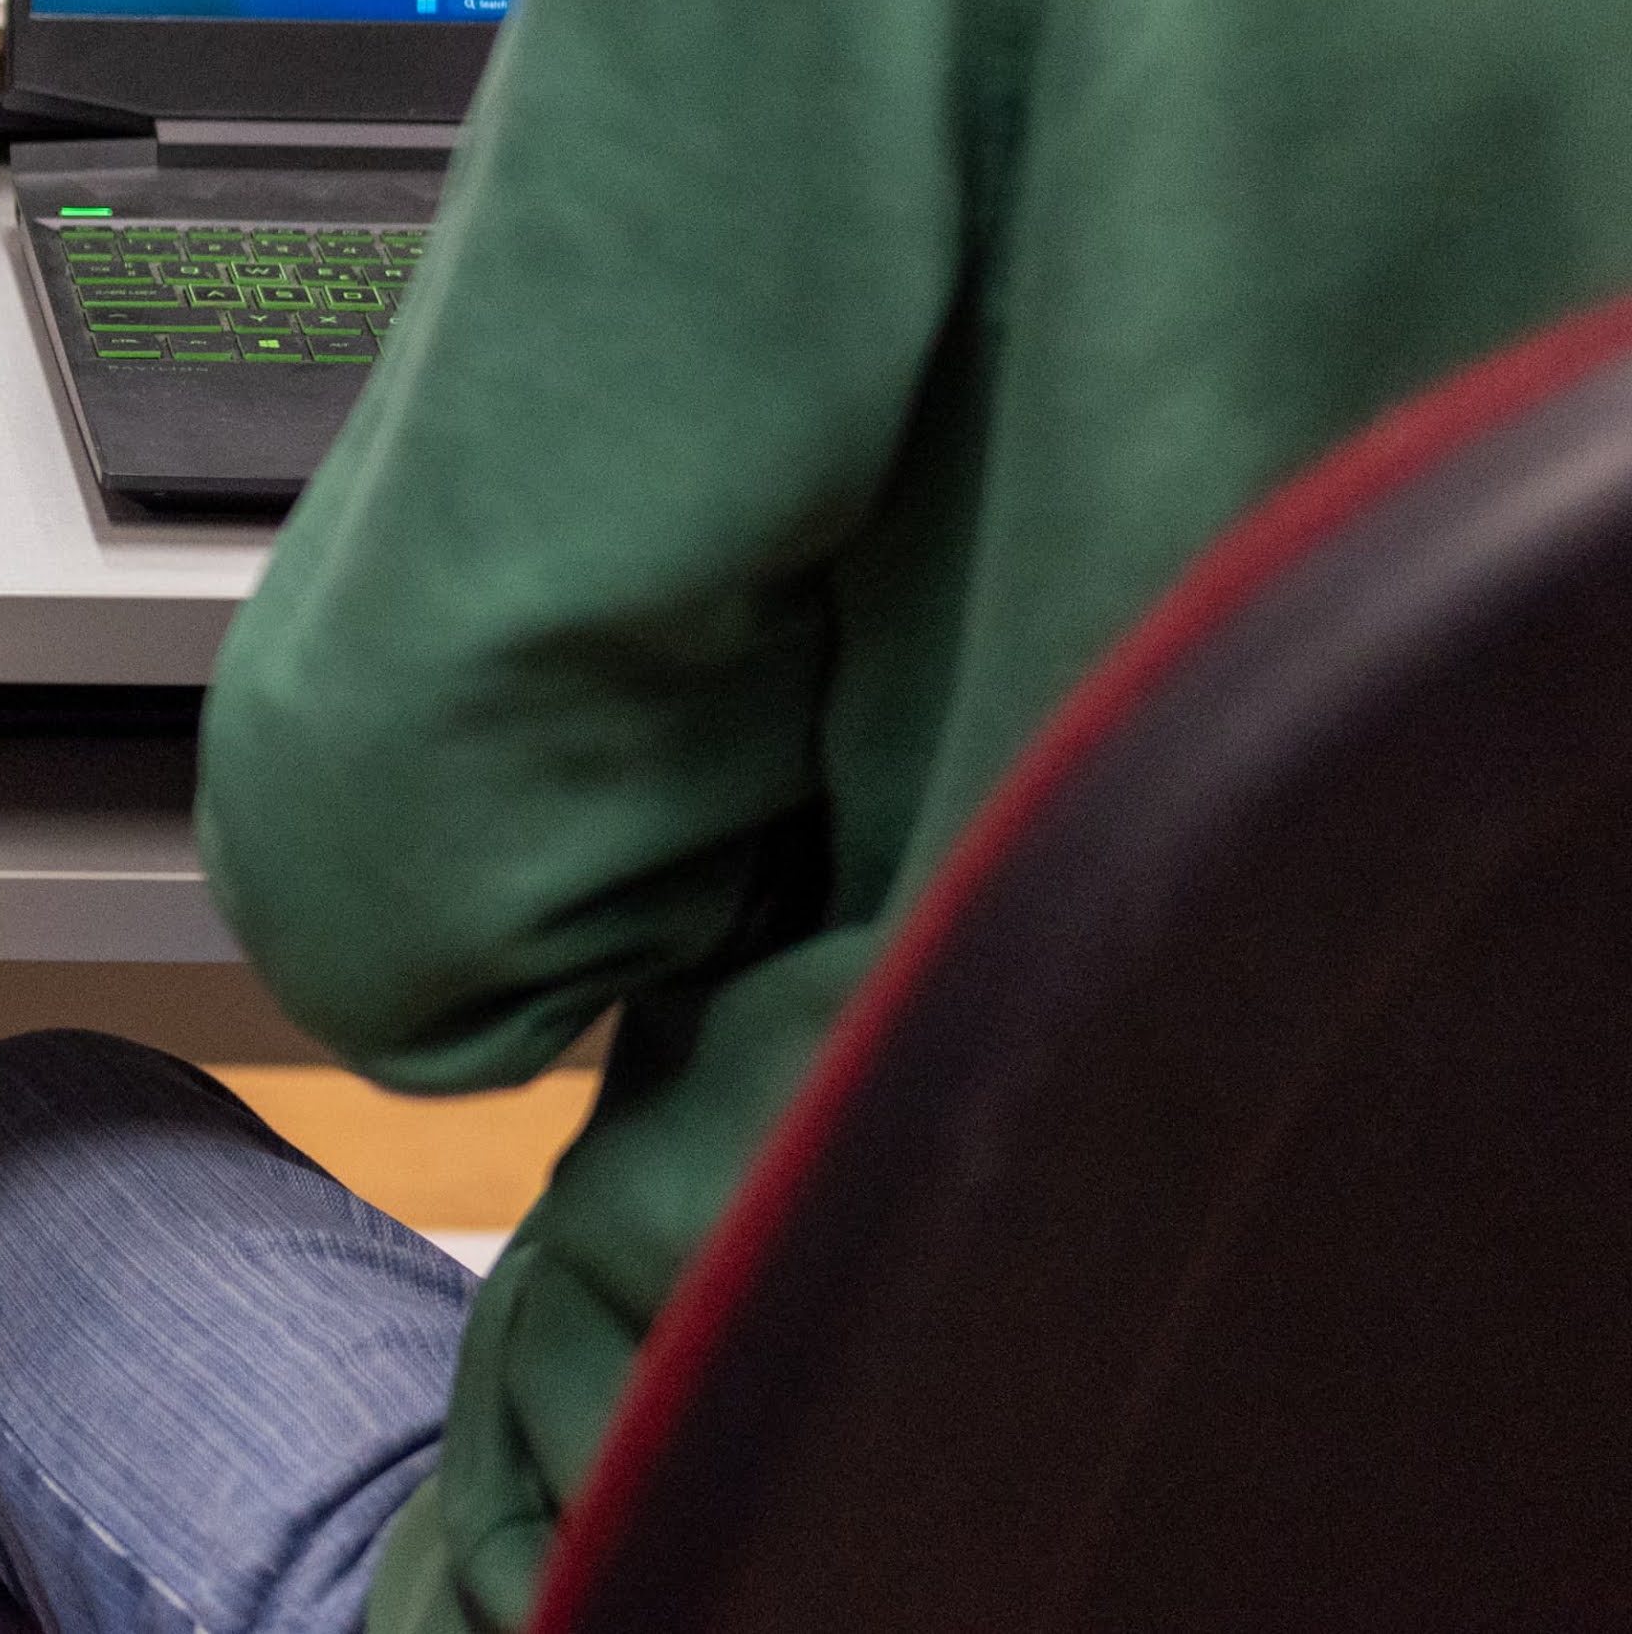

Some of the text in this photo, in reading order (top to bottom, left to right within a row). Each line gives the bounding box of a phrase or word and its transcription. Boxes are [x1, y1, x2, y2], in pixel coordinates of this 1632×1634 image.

[244, 267, 269, 275] W
[207, 290, 225, 298] A
[319, 315, 337, 323] X
